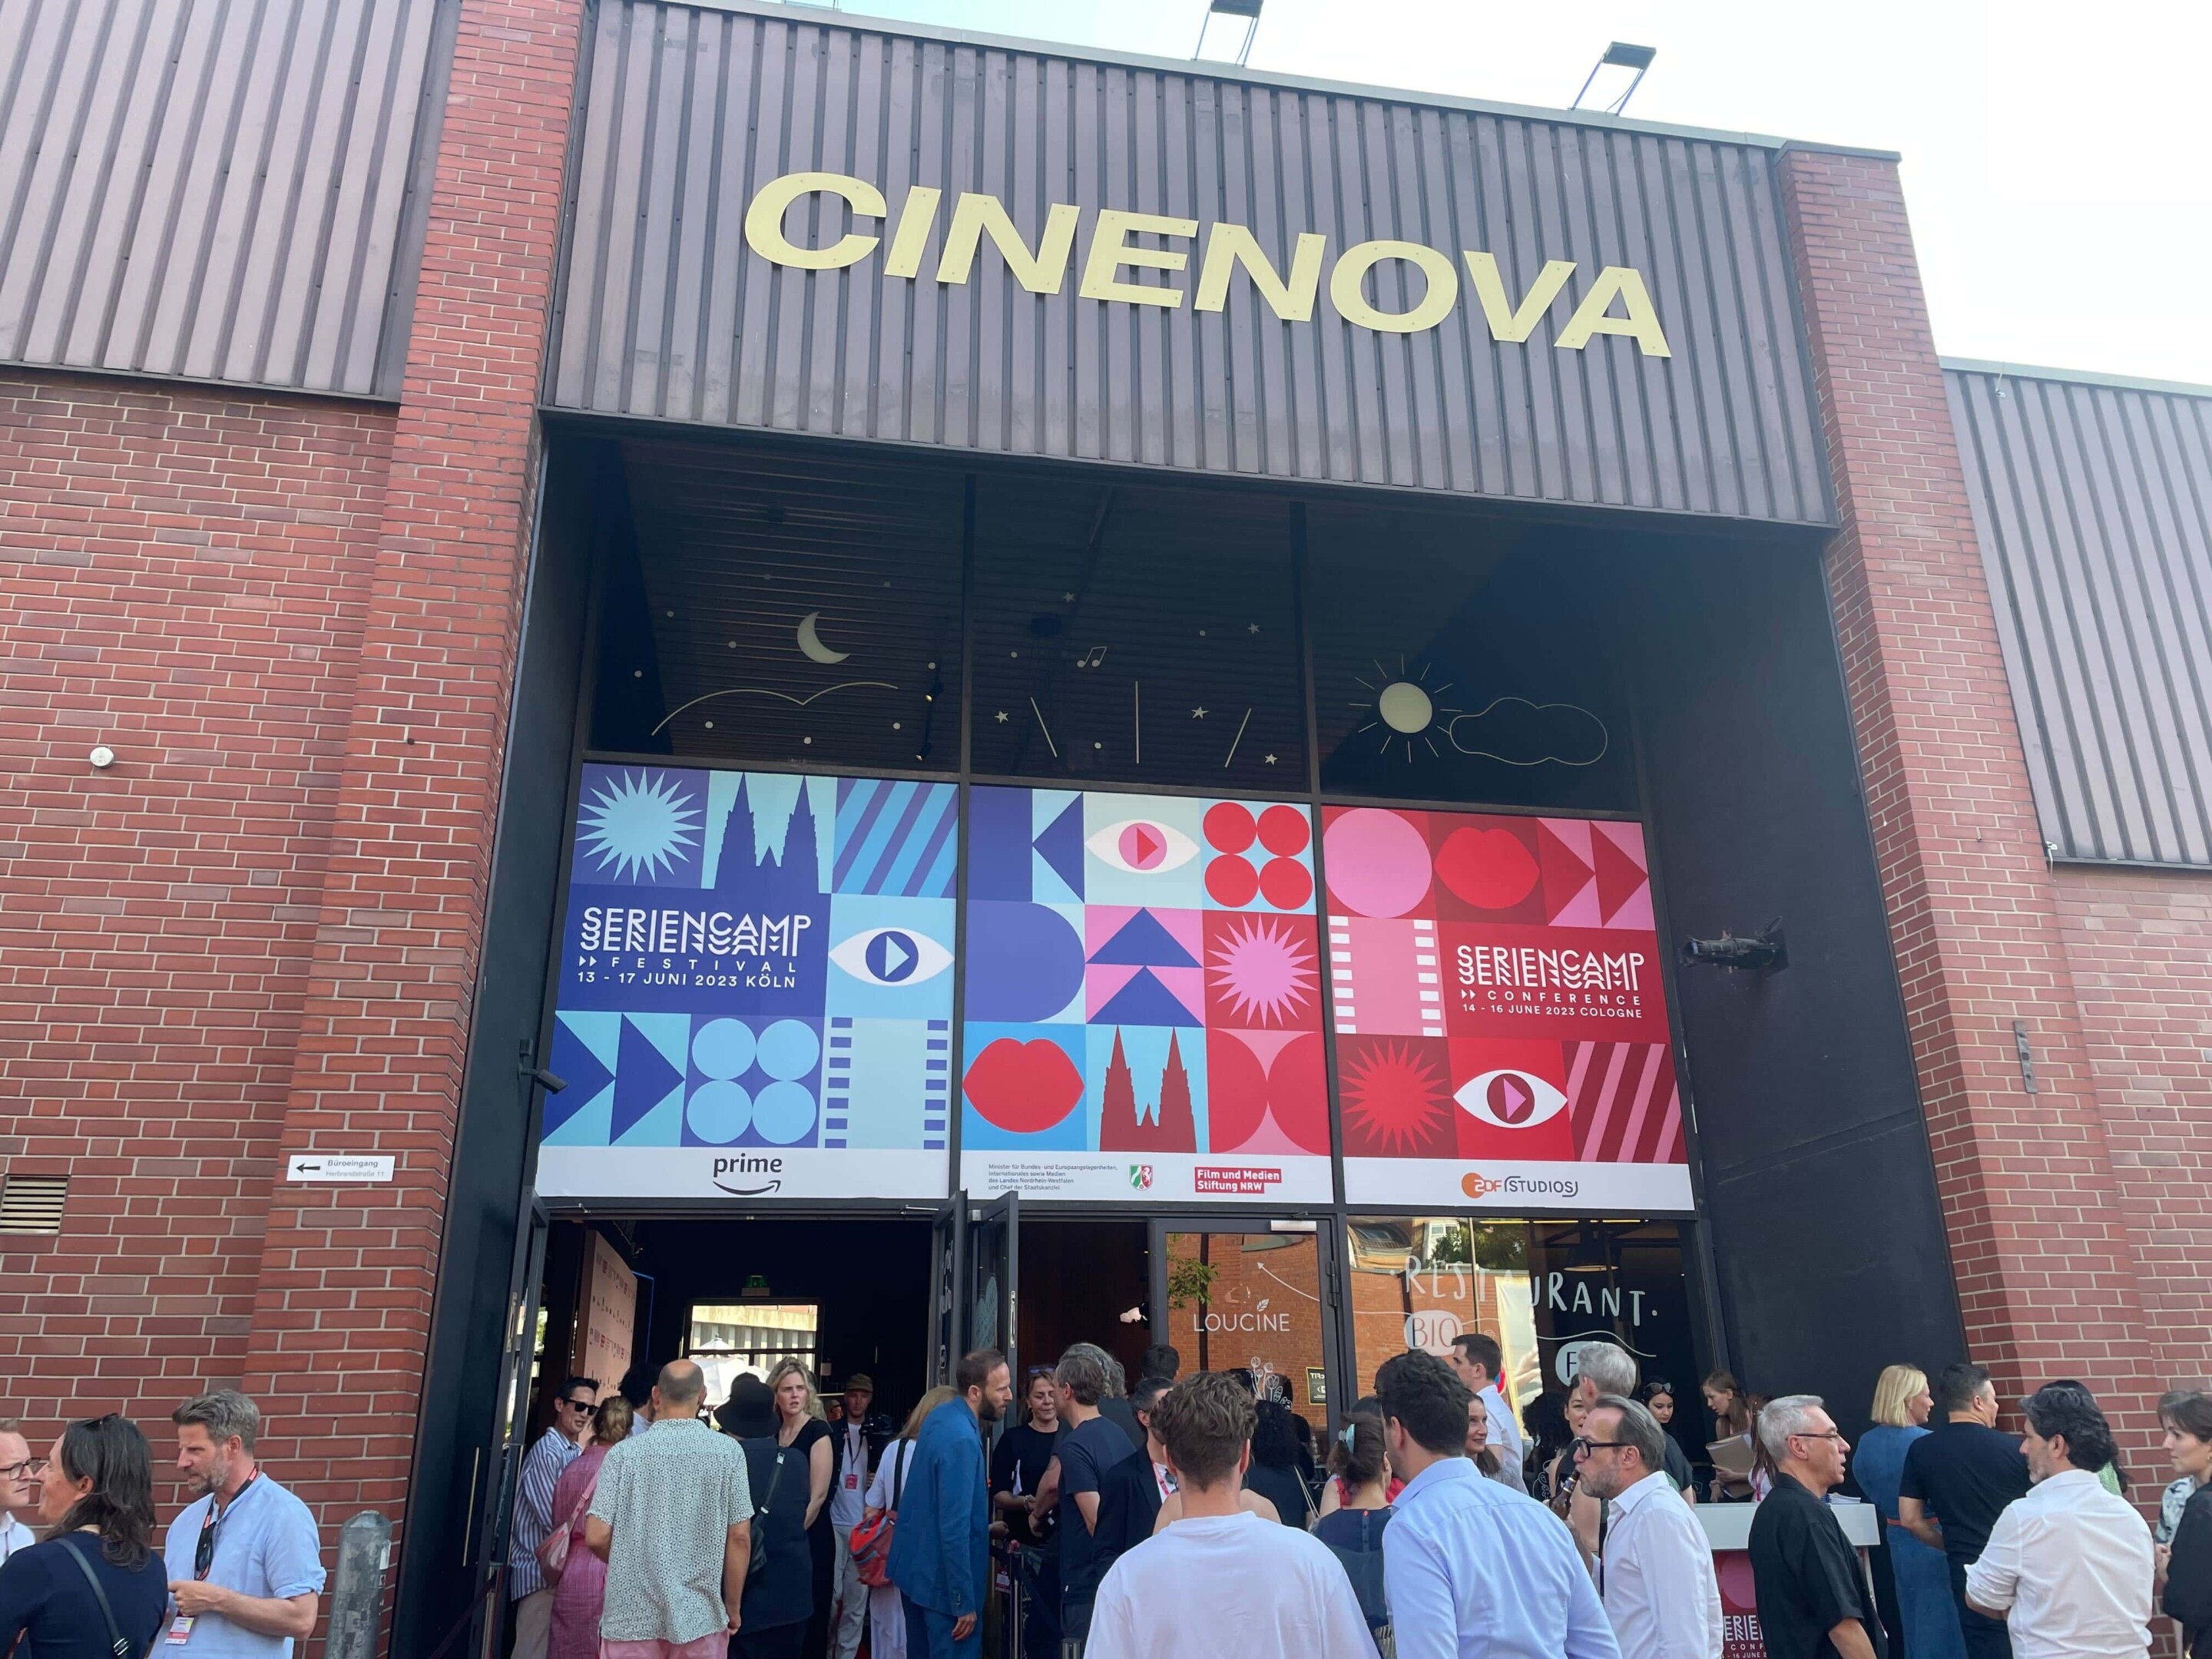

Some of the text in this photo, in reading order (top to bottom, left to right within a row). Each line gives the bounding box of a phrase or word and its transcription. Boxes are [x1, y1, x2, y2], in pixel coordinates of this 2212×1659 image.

[745, 171, 1671, 358] CINENOVA
[580, 906, 812, 957] SERIENCAMP
[611, 957, 796, 973] FESTIVAL
[1457, 945, 1644, 992] SERIENCAMP
[578, 972, 595, 982] 13
[618, 972, 636, 984] 17
[644, 973, 687, 985] JUNI
[695, 975, 737, 987] 2023
[746, 973, 795, 988] KÖLN
[1487, 990, 1641, 1006] CONFERENCE
[1463, 1004, 1476, 1012] 14
[1491, 1005, 1504, 1013] 16
[1508, 1005, 1541, 1015] JUNE
[1545, 1006, 1575, 1016] 2023
[1580, 1007, 1642, 1018] COLOGNE
[327, 1159, 379, 1168] Büroeingang
[713, 1152, 783, 1178] prime
[1197, 1169, 1280, 1181] Film und Medien
[1197, 1181, 1263, 1192] Stiftung NRW
[1473, 1179, 1502, 1192] ZDF
[1193, 1313, 1291, 1332] LOUCINE
[1412, 1316, 1459, 1346] BIO
